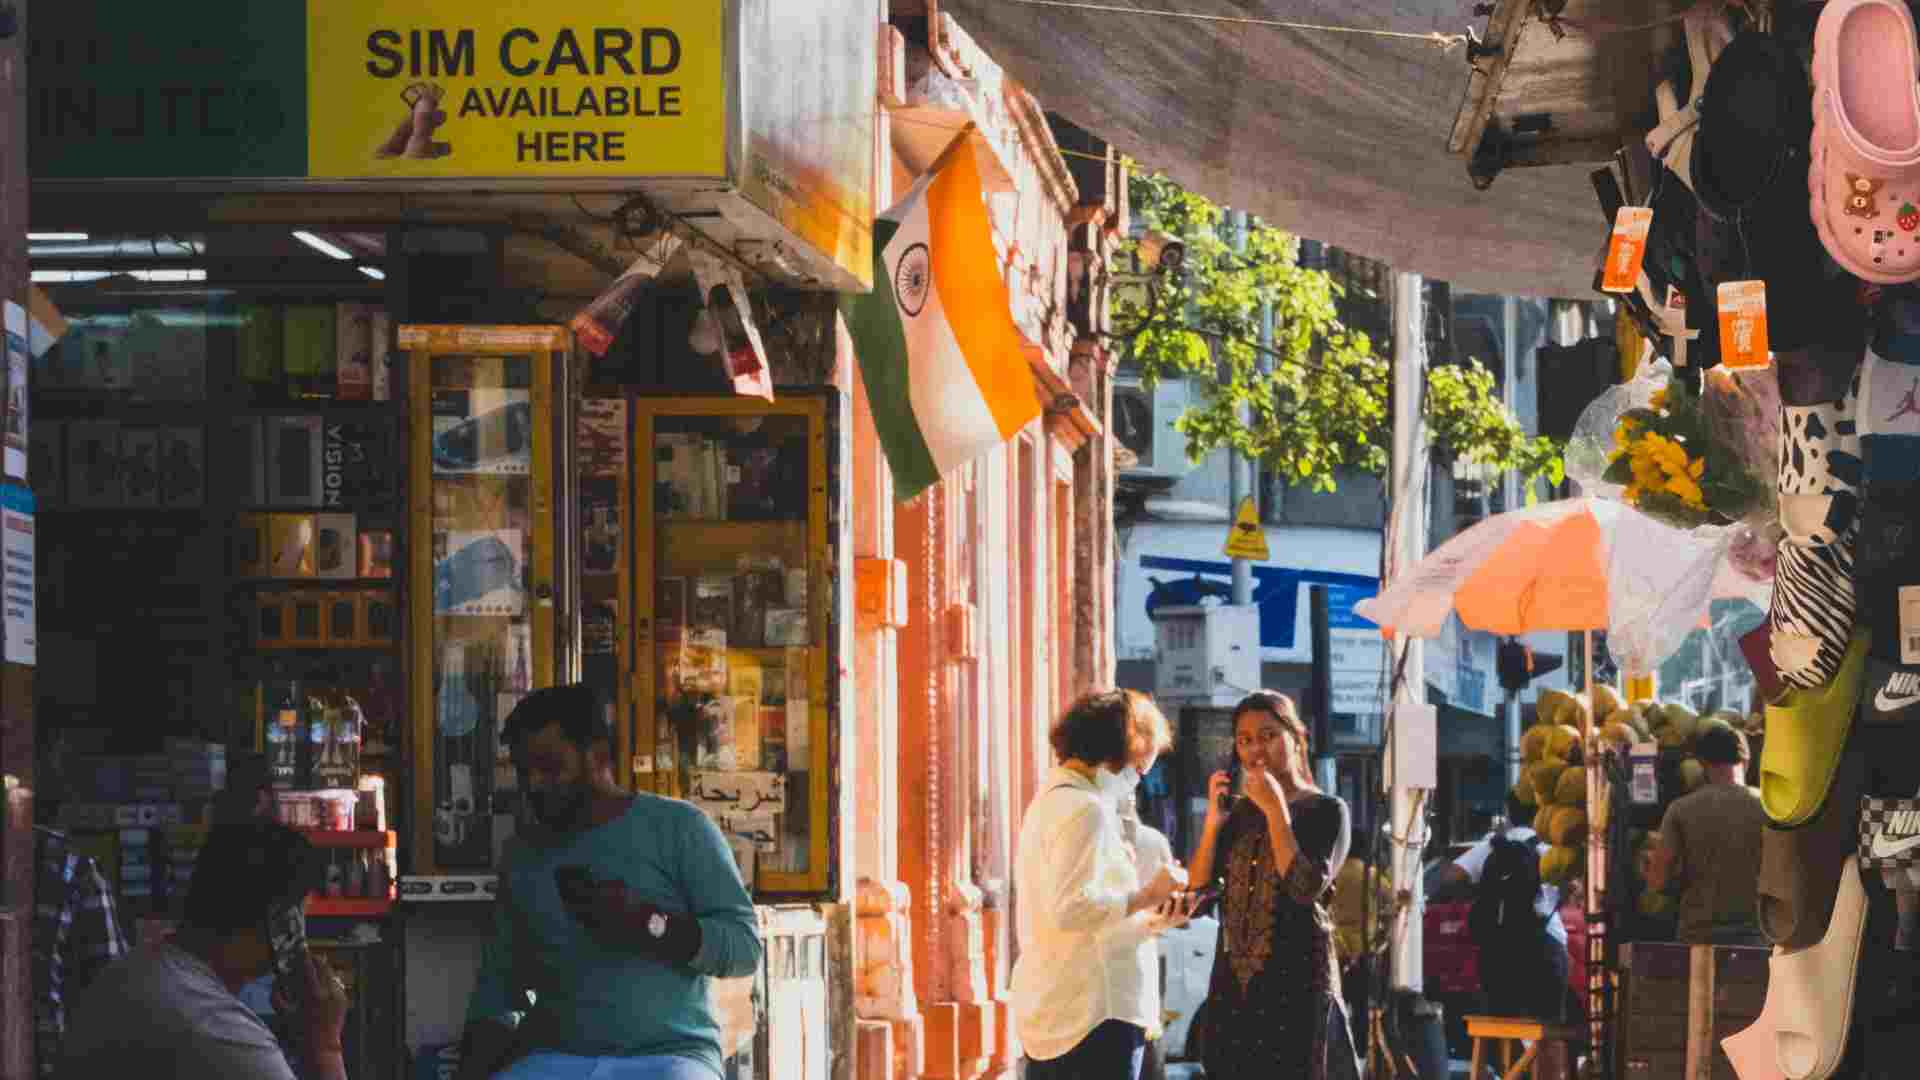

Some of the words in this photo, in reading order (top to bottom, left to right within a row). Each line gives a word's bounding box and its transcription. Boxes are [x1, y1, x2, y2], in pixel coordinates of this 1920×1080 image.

[366, 28, 475, 78] SIM
[500, 27, 682, 76] CARD
[458, 86, 682, 118] AVAILABLE
[517, 130, 626, 162] HERE
[325, 423, 344, 506] VISION
